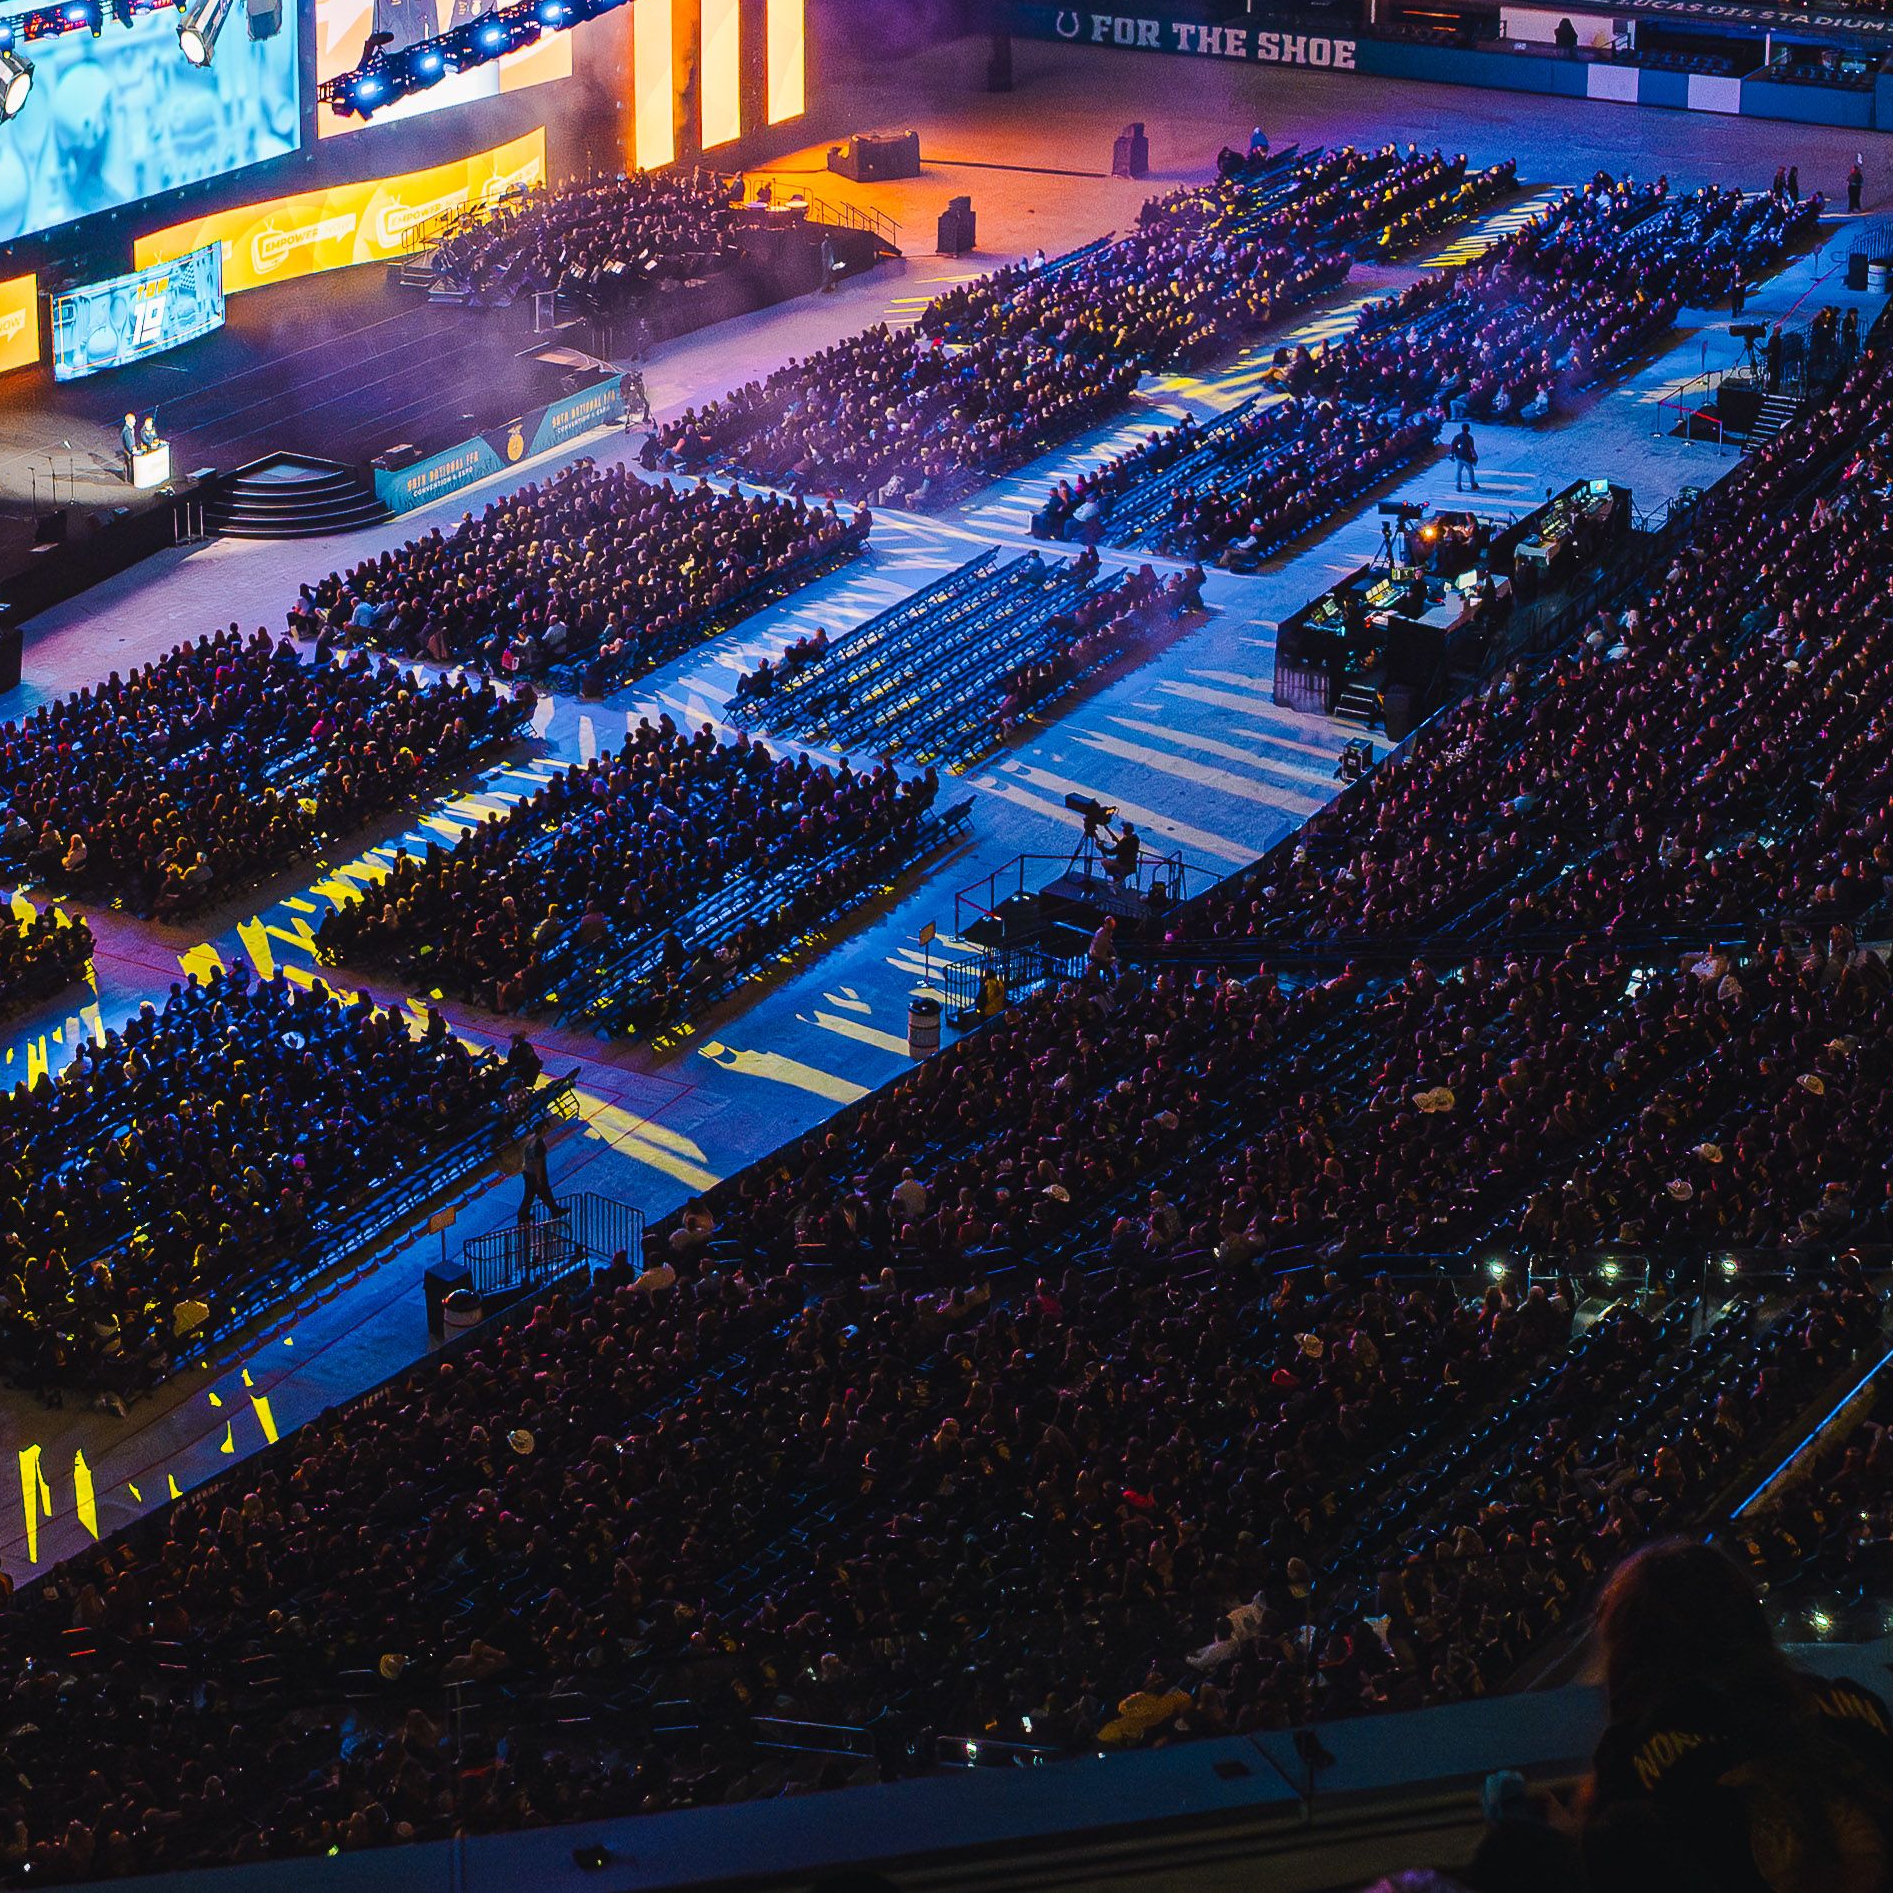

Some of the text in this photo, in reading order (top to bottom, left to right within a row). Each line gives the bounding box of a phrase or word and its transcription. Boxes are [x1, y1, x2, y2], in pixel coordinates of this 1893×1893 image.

[1758, 10, 1886, 31] STADIUM
[1091, 14, 1355, 69] FOR THE SHOE
[391, 203, 441, 227] EMPOWER
[265, 227, 319, 253] EMPOWER
[137, 277, 169, 300] TOP
[413, 475, 451, 498] CONVENTION
